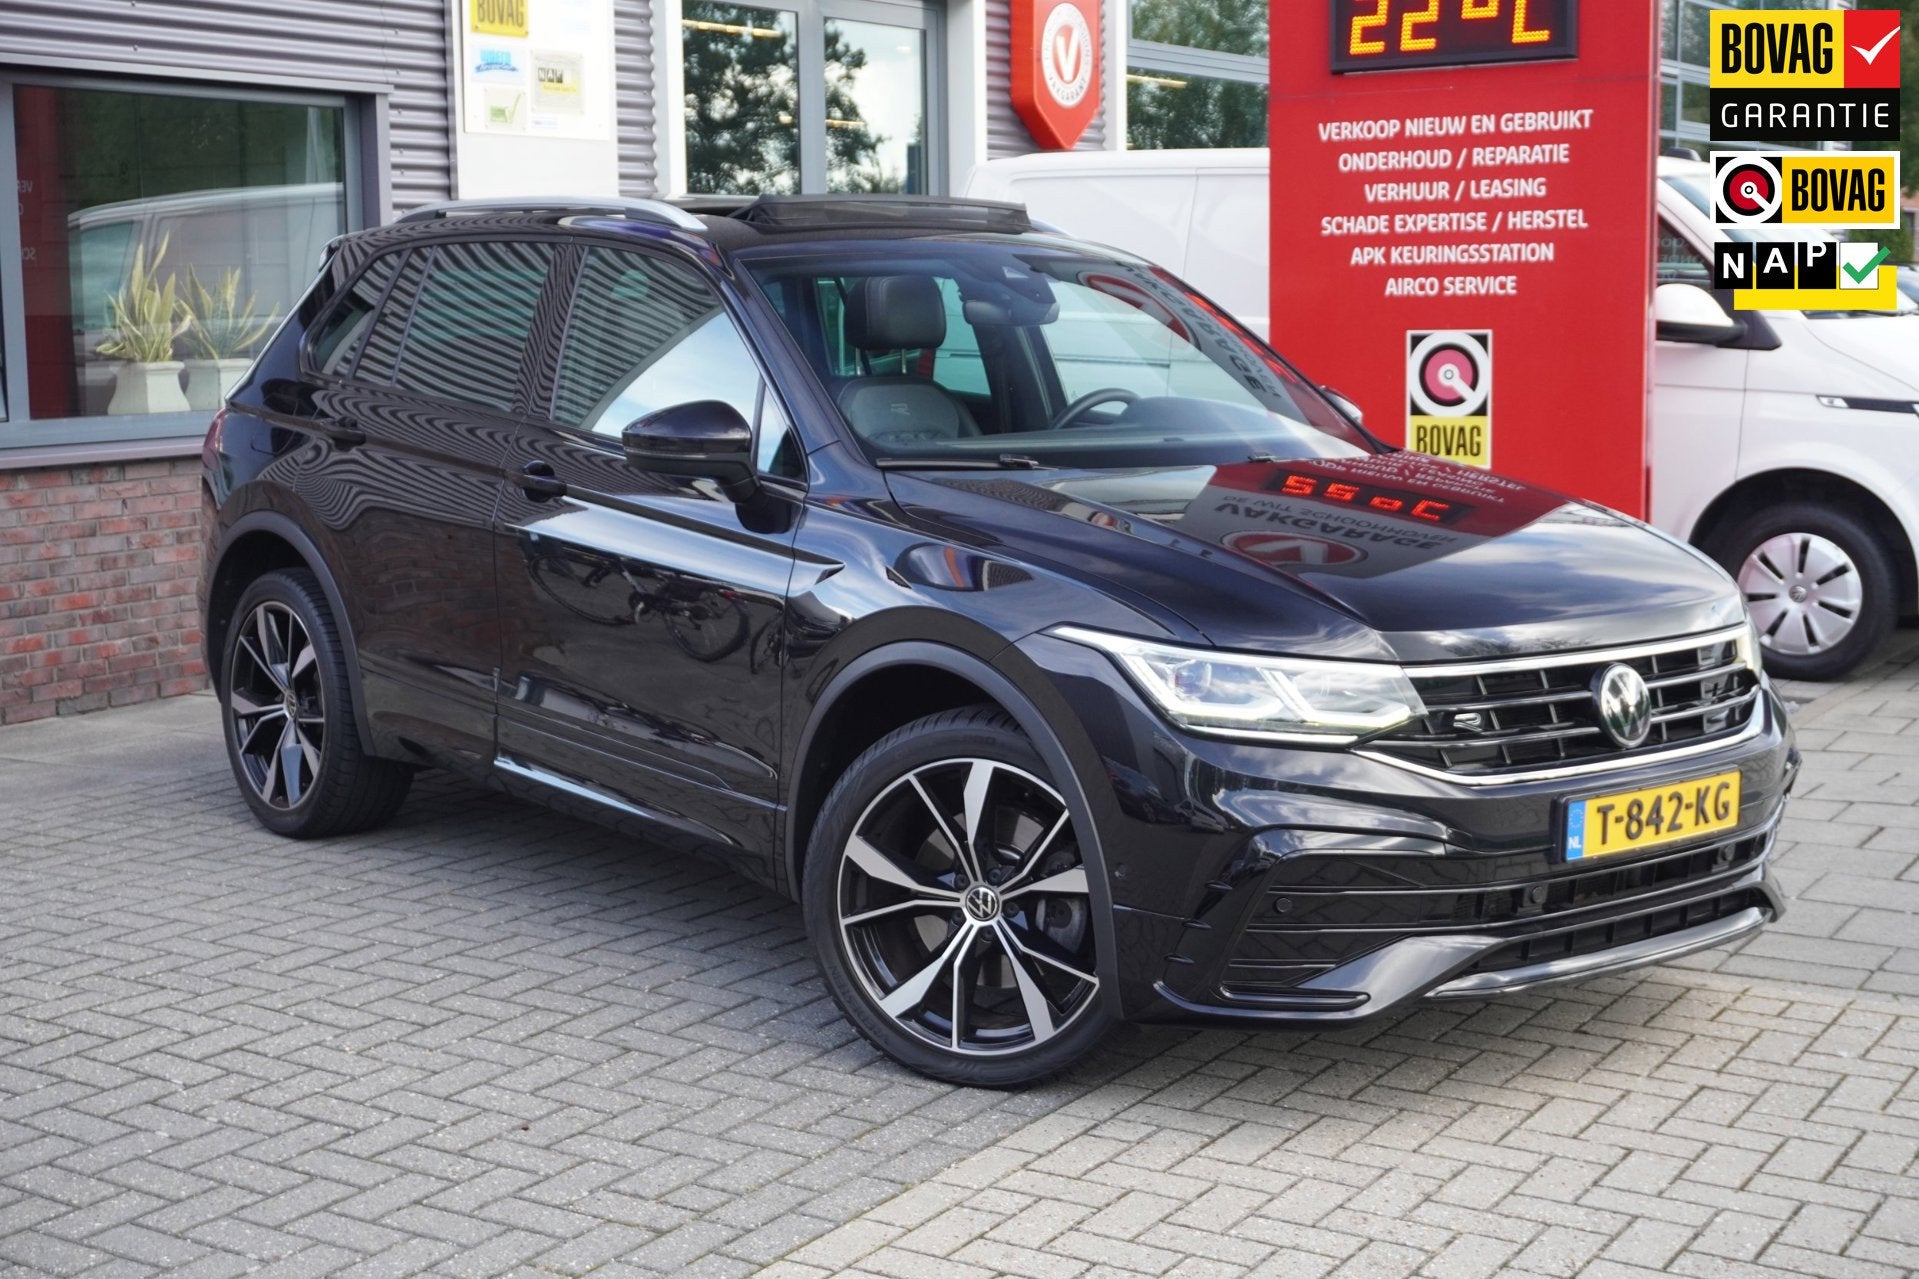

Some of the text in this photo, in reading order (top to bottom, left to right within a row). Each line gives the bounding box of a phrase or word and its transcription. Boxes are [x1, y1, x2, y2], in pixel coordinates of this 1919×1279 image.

[1319, 109, 1593, 142] VERKOOP NIEUW EN GEBRUIKT
[1338, 149, 1452, 172] ONDERHOUD
[1472, 143, 1570, 166] REPARATIE
[1365, 181, 1450, 202] VERHUUR
[1470, 177, 1547, 199] LEASING
[1321, 215, 1390, 235] SCHADE
[1394, 212, 1487, 233] EXPERTISE
[1508, 209, 1589, 230] HERSTEL
[1351, 243, 1554, 265] APK KEURINGSSTATION
[1385, 275, 1518, 297] AIRCO SERVICE
[1416, 424, 1481, 457] BOVAG
[1597, 781, 1730, 845] T-842-KG
[1568, 835, 1582, 850] NL
